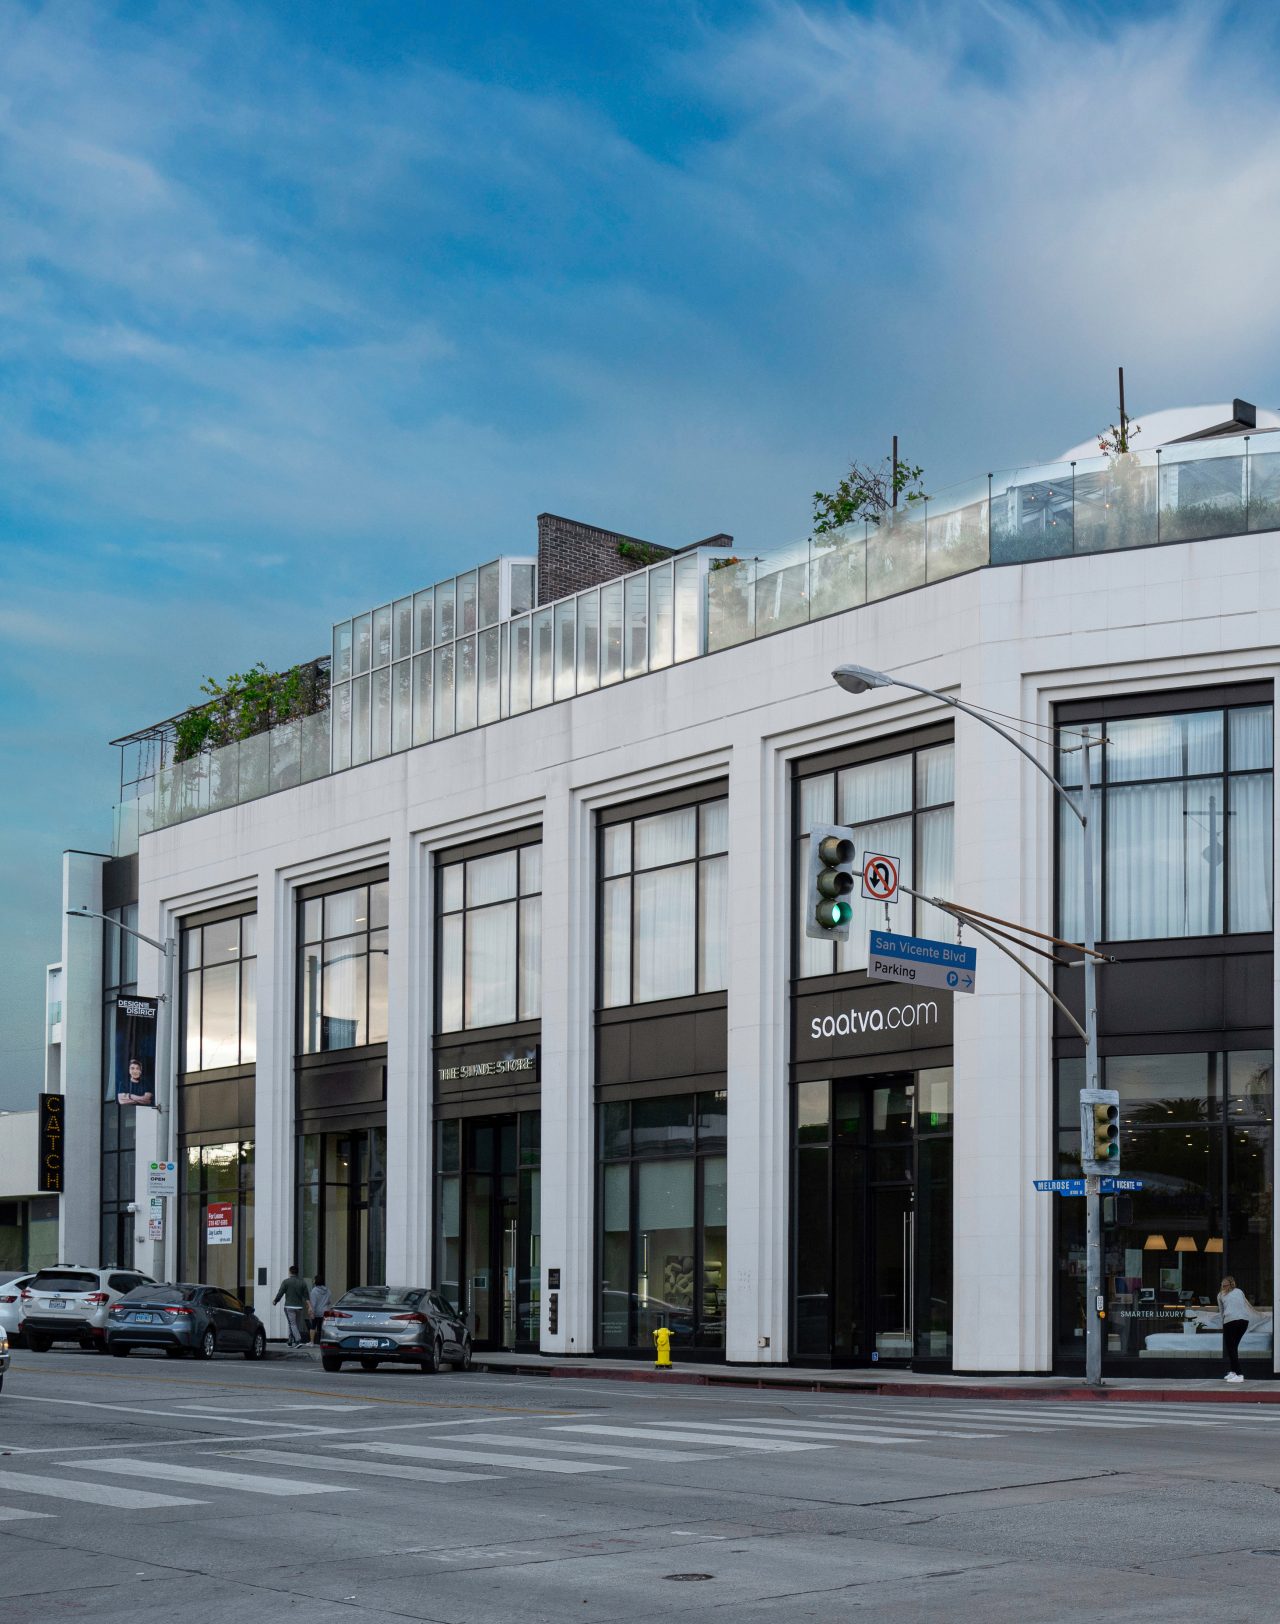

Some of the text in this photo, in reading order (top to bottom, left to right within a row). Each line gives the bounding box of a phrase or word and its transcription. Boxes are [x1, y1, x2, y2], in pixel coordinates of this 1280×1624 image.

[875, 937, 967, 963] San Vicente Blvd
[874, 961, 917, 980] Parking
[118, 1000, 144, 1008] DESIGN
[126, 1006, 156, 1016] DISTRICT
[811, 1001, 938, 1039] saatva.com
[438, 1066, 460, 1080] THE
[496, 1057, 533, 1074] STORE
[47, 1097, 60, 1188] CATCH
[1037, 1180, 1070, 1191] MELROSE
[1120, 1310, 1185, 1318] SMARTER LUXURY
